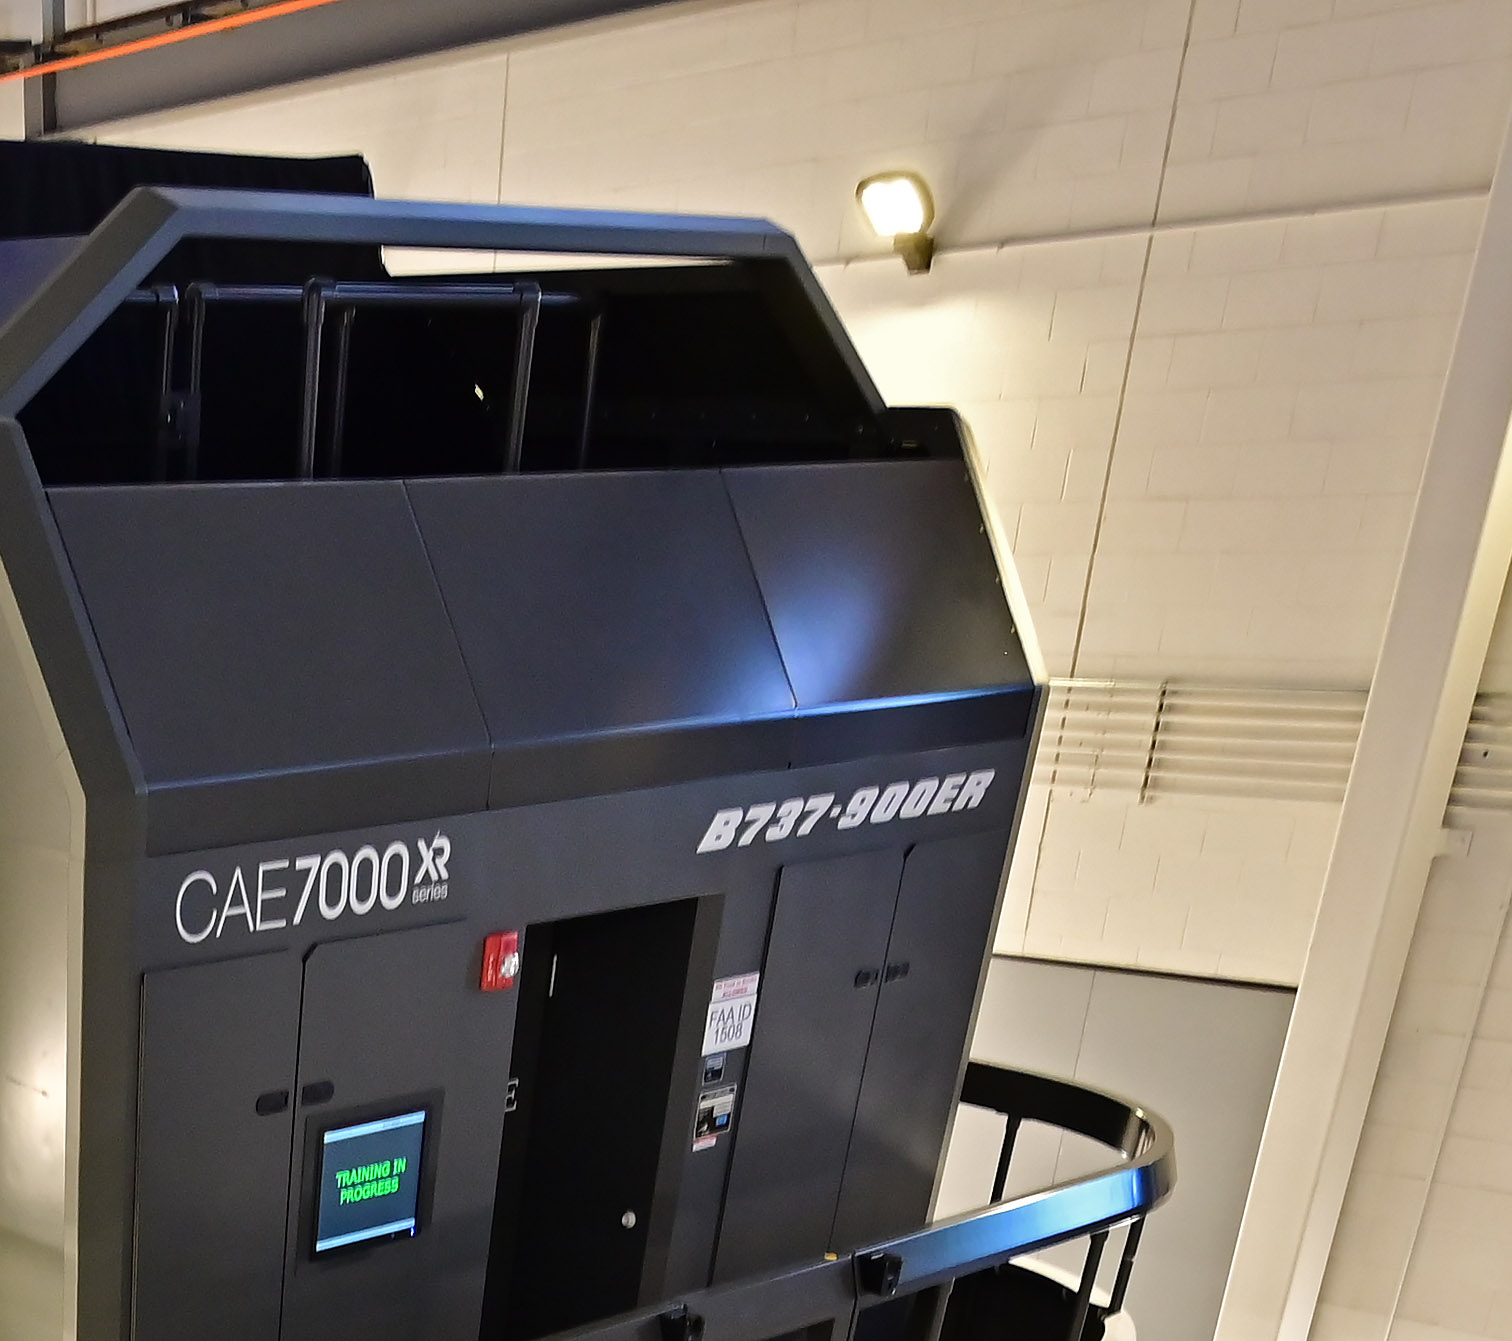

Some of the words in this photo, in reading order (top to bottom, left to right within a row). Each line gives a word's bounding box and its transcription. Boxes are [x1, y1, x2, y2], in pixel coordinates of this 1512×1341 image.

[708, 1006, 735, 1030] FAA
[738, 1003, 752, 1022] ID
[336, 1160, 391, 1189] TRAINING
[392, 1156, 407, 1176] IN
[339, 1176, 400, 1206] PROGRESS
